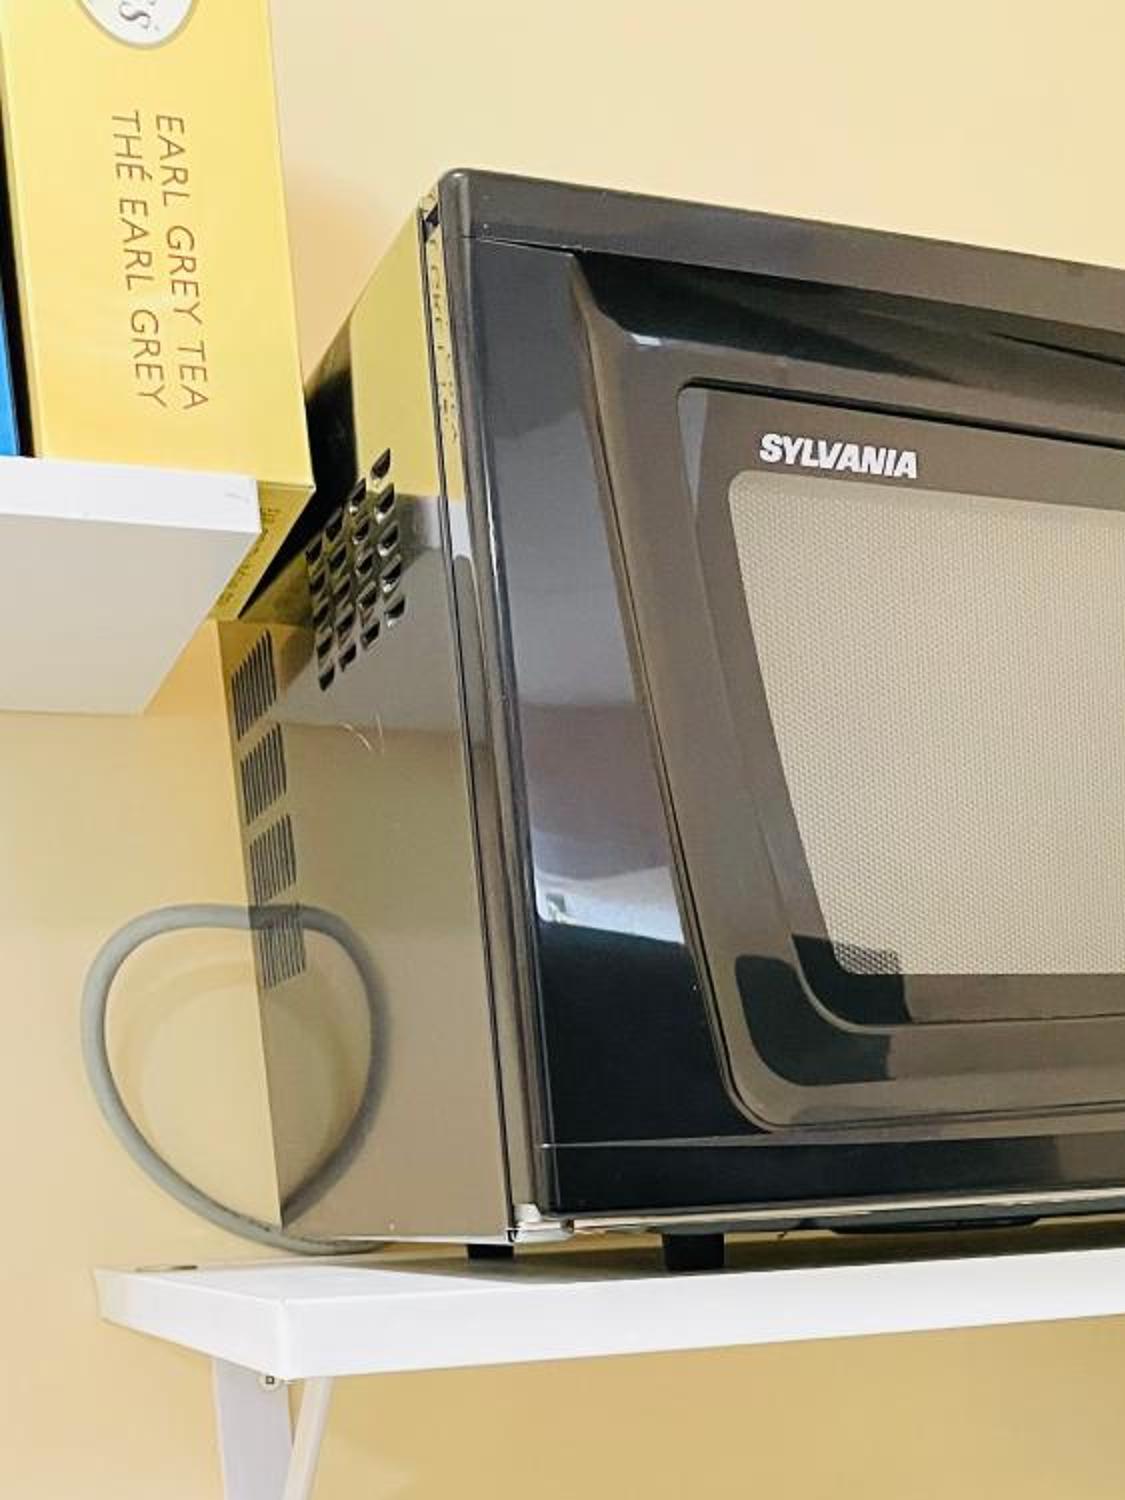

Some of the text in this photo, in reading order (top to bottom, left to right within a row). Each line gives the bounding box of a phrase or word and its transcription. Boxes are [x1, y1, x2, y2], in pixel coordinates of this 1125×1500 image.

[111, 110, 168, 408] THÉ EARL GREY
[155, 113, 209, 410] EARL GREY TEA
[759, 433, 917, 479] SYLVANIA
